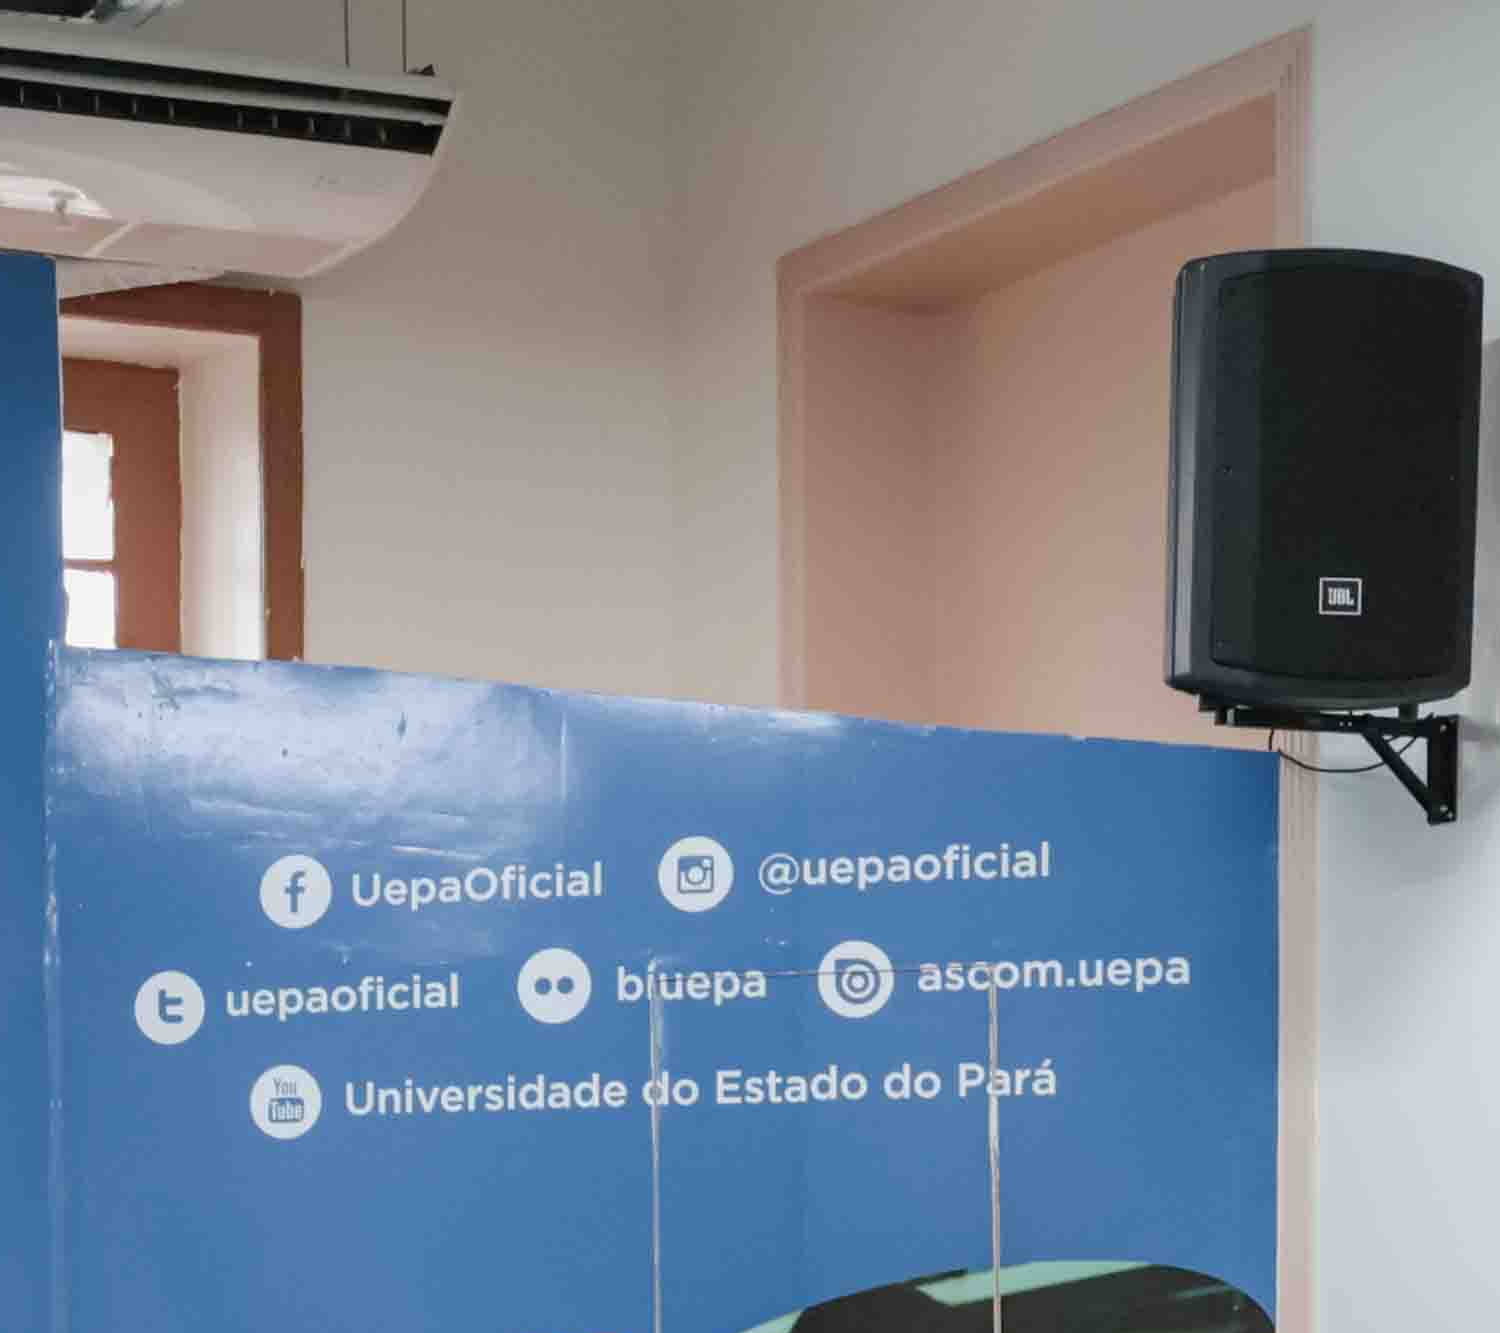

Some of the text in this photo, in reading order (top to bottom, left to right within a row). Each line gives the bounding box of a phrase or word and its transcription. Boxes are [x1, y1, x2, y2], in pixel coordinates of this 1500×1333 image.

[350, 862, 605, 911] UepaOficial
[757, 842, 1052, 896] @uepaoficial
[225, 974, 461, 1021] uepaoficial
[916, 950, 1193, 999] ascom.uepa
[344, 1056, 1058, 1119] Universidade do Estado do Pará
